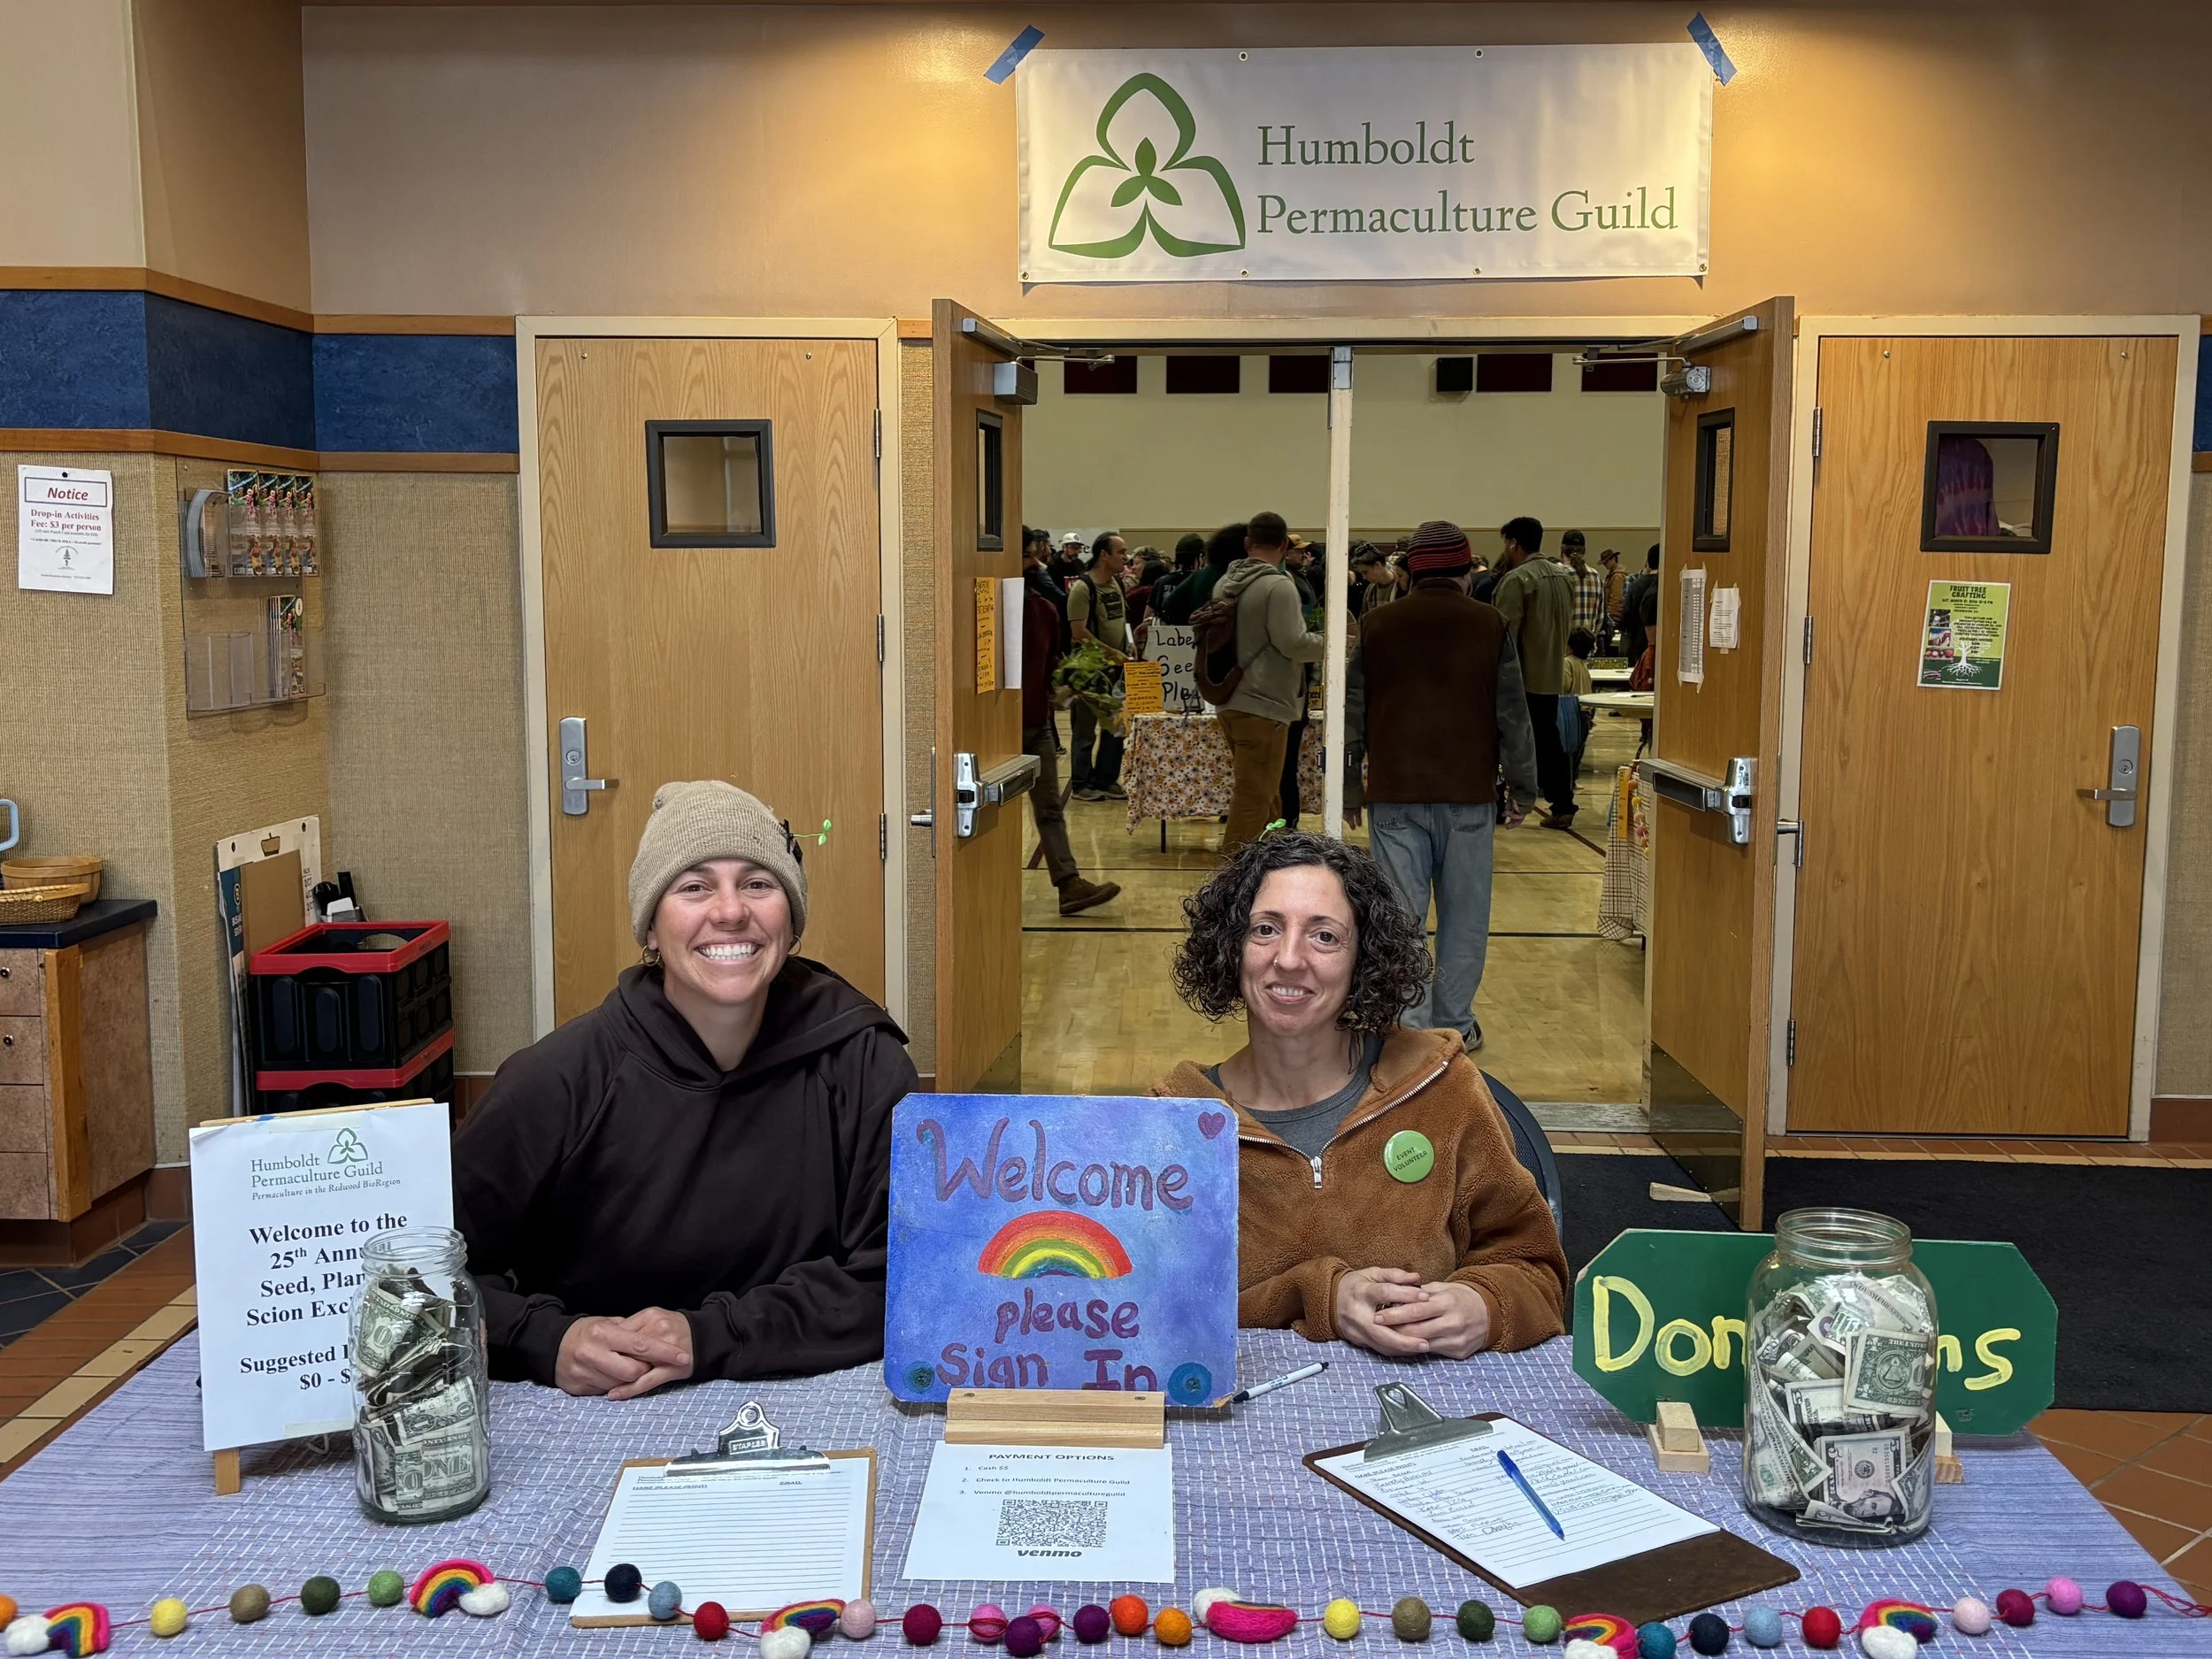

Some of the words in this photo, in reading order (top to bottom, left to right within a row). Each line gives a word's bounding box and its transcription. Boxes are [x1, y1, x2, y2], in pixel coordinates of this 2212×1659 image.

[1257, 121, 1475, 166] Humboldt
[1257, 190, 1539, 236] Permaculture
[1551, 187, 1679, 233] Guild
[47, 487, 88, 501] Notice
[31, 509, 62, 519] Drop-in
[64, 511, 100, 521] Activities
[31, 519, 48, 528] Fee:
[1156, 627, 1194, 647] Labe
[250, 1153, 320, 1172] Humboldt
[916, 1117, 1194, 1212] Welcome
[1393, 1150, 1428, 1172] VOLUNTEER
[1396, 1147, 1416, 1161] EVENT
[251, 1169, 341, 1188] Permaculture
[343, 1161, 383, 1179] Guild
[252, 1188, 303, 1201] Permaculture
[328, 1182, 361, 1193] Redwood
[363, 1179, 401, 1189] BioRegion
[249, 1223, 344, 1245] Welcome
[350, 1218, 370, 1233] to
[376, 1213, 408, 1230] the
[270, 1247, 307, 1270] 25th
[260, 1276, 316, 1298] Seed,
[247, 1306, 303, 1326] Scion
[993, 1286, 1141, 1343] please
[240, 1346, 335, 1374] Suggested
[935, 1343, 1049, 1389] Sign
[1082, 1348, 1157, 1391] In
[300, 1372, 322, 1390] $0
[732, 1440, 766, 1452] STAPLES
